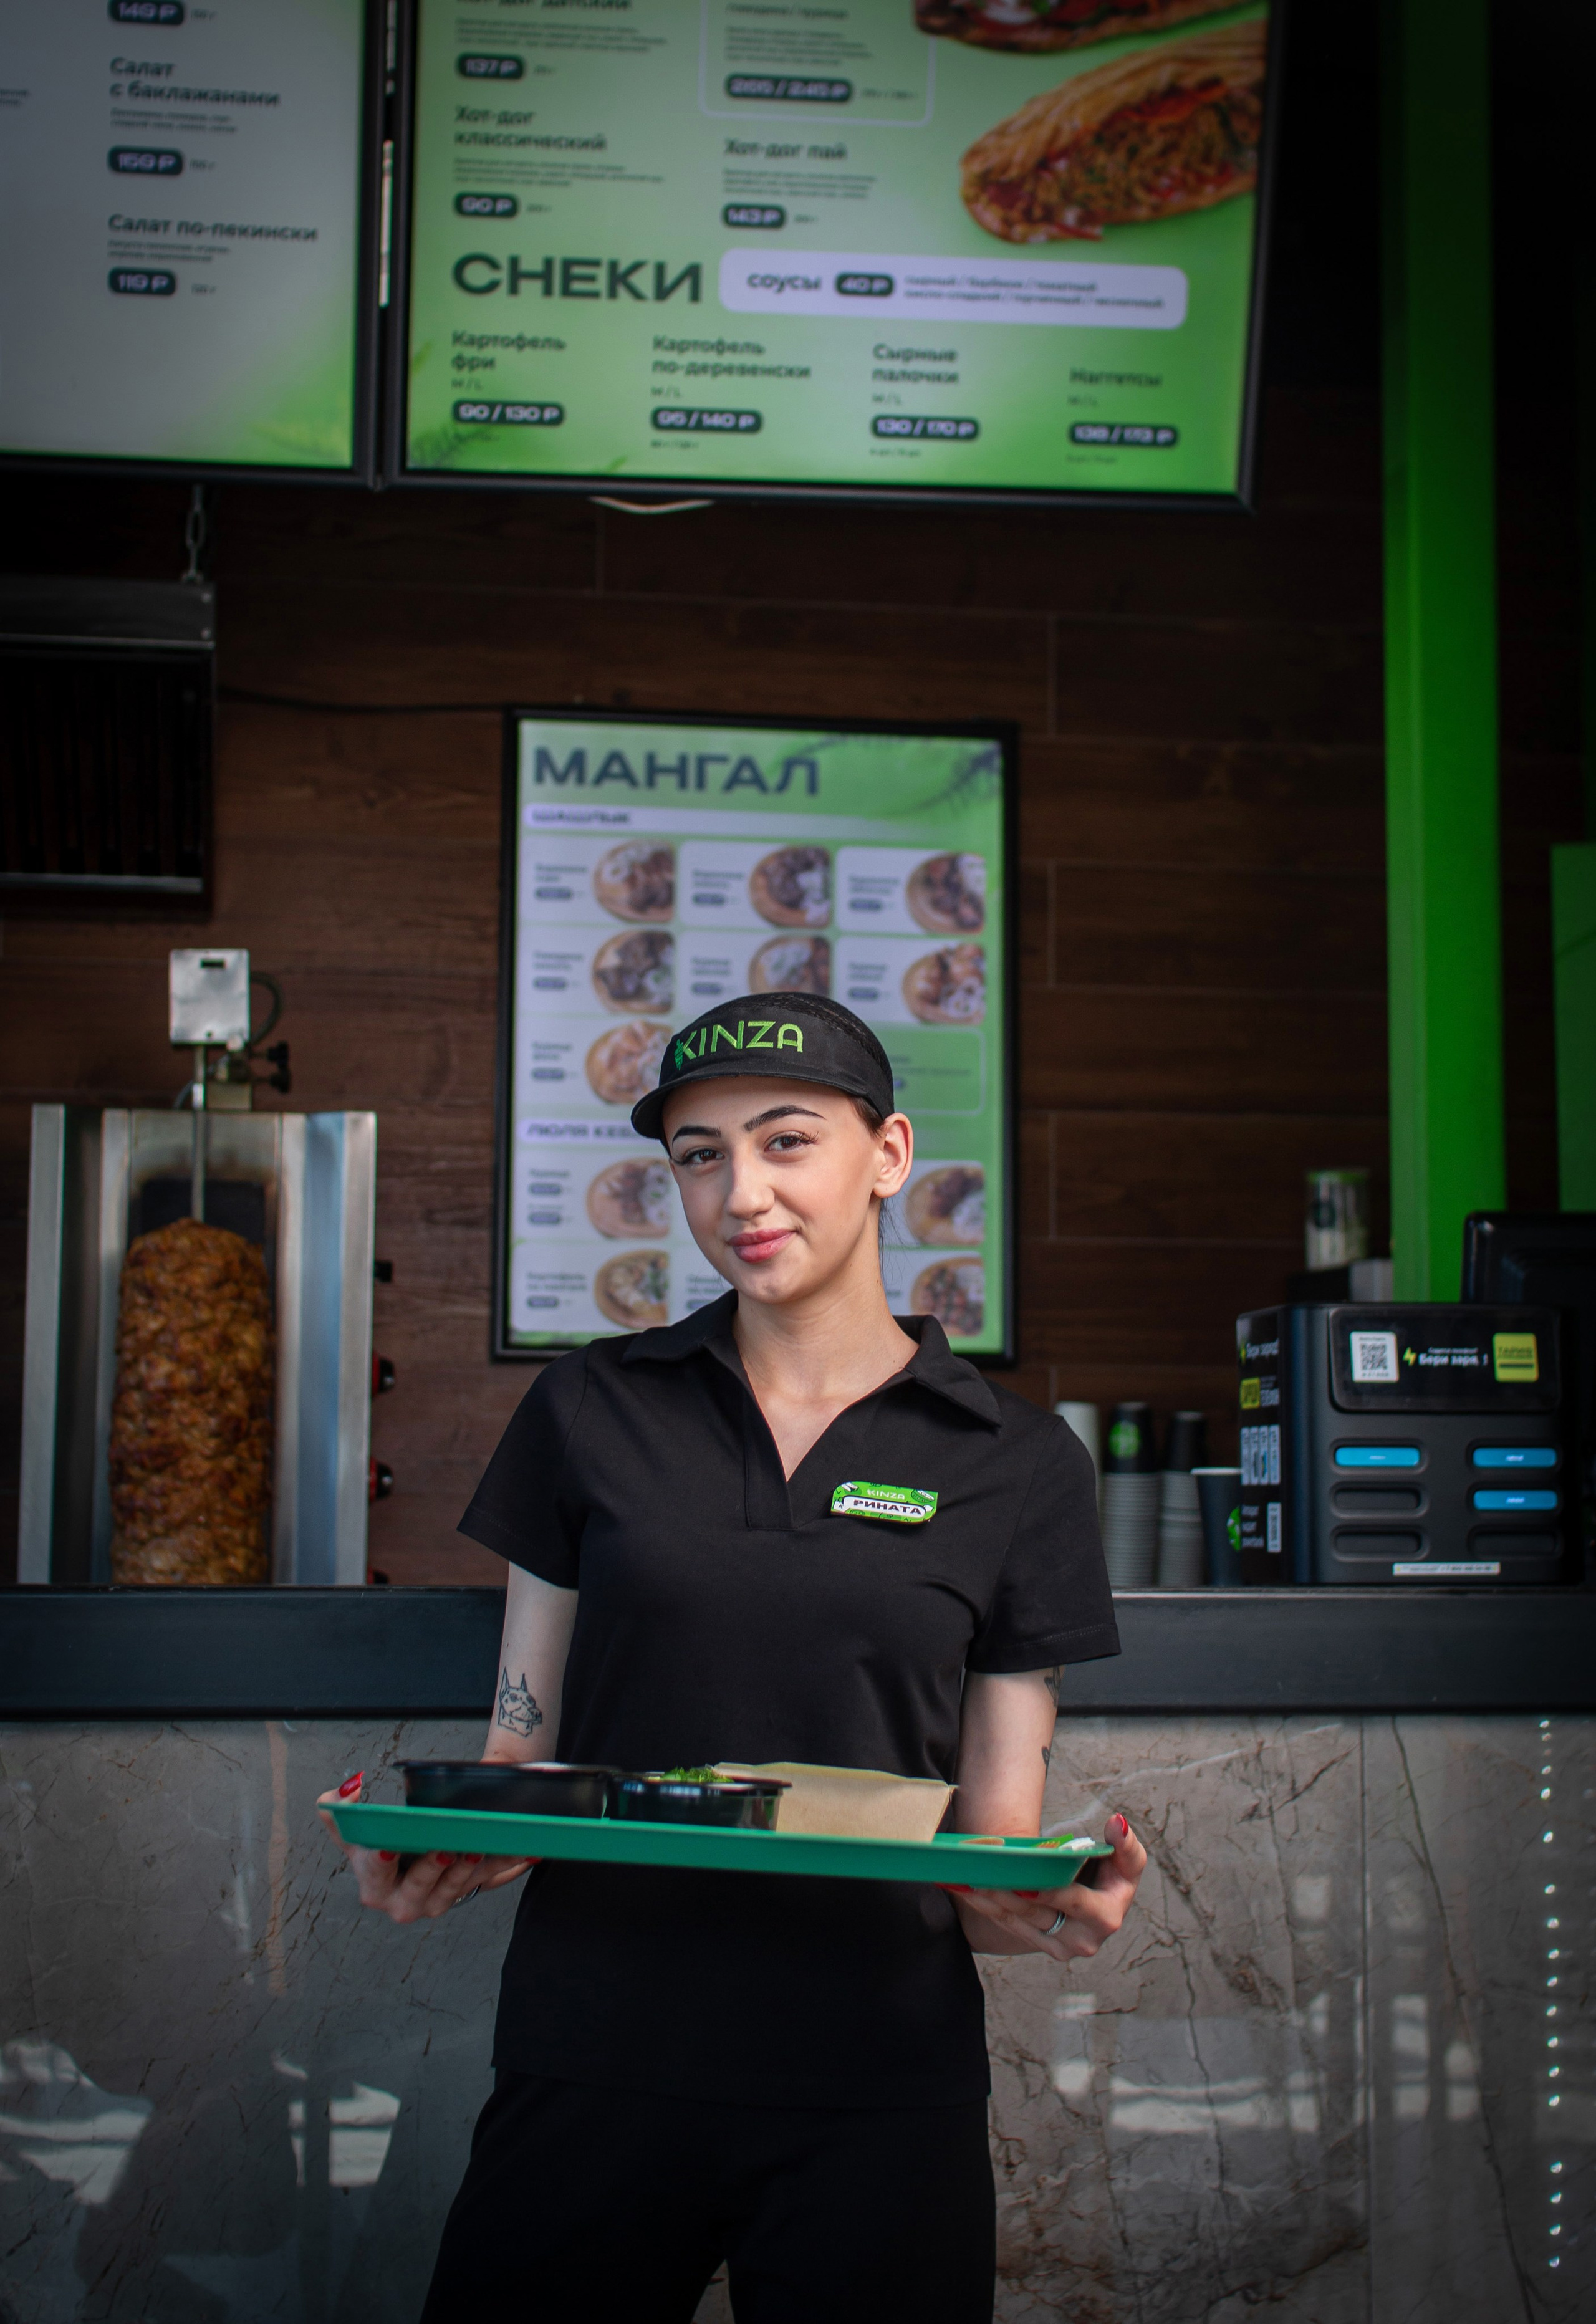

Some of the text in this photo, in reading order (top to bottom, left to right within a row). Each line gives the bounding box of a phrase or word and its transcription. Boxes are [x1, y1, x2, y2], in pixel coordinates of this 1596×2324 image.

[109, 57, 175, 77] Салат
[109, 82, 281, 107] с баклажанами
[454, 105, 536, 126] Хот-дог
[454, 132, 607, 150] классический
[724, 138, 802, 158] Хот-дог
[461, 197, 493, 213] 90
[108, 214, 318, 241] Салат по-пекински
[453, 252, 704, 304] СНЕКИ
[747, 272, 823, 294] соусы
[840, 277, 870, 293] 40
[452, 331, 566, 352] Картофель
[653, 335, 766, 356] Картофель
[451, 352, 495, 373] фри
[873, 344, 958, 364] Сырные
[652, 360, 811, 379] по-деревенски
[872, 369, 959, 384] палочки
[459, 403, 489, 419] 90
[491, 404, 502, 421] /
[505, 405, 541, 421] 130
[688, 411, 699, 428] /
[702, 413, 736, 428] 140
[877, 419, 912, 435] 130
[912, 420, 925, 436] /
[1110, 426, 1122, 443] /
[534, 747, 819, 795] МАНГАЛ
[532, 810, 630, 824] ШАШЛЫК
[675, 1020, 804, 1068] KINZA
[527, 1124, 588, 1138] ЛЮЛЯ
[867, 1489, 905, 1500] KINZA
[853, 1499, 921, 1515] РИНАТА
